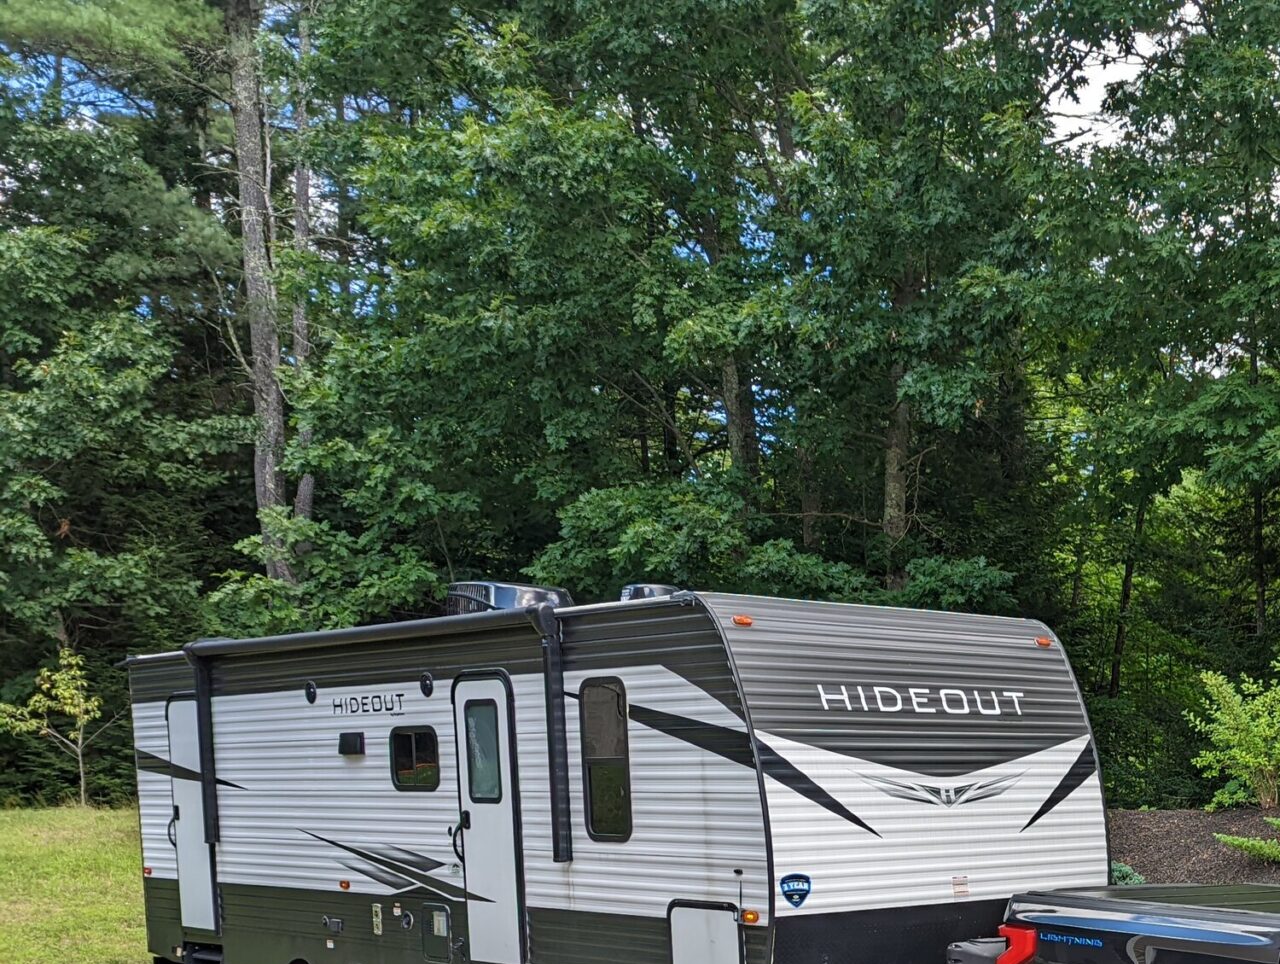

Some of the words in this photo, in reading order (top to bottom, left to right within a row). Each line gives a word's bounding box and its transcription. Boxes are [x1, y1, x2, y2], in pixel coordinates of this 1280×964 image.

[332, 693, 405, 715] HIDEOUT
[815, 684, 1024, 716] HIDEOUT
[788, 881, 809, 890] YEAR
[1040, 932, 1103, 948] LIGHTNING
